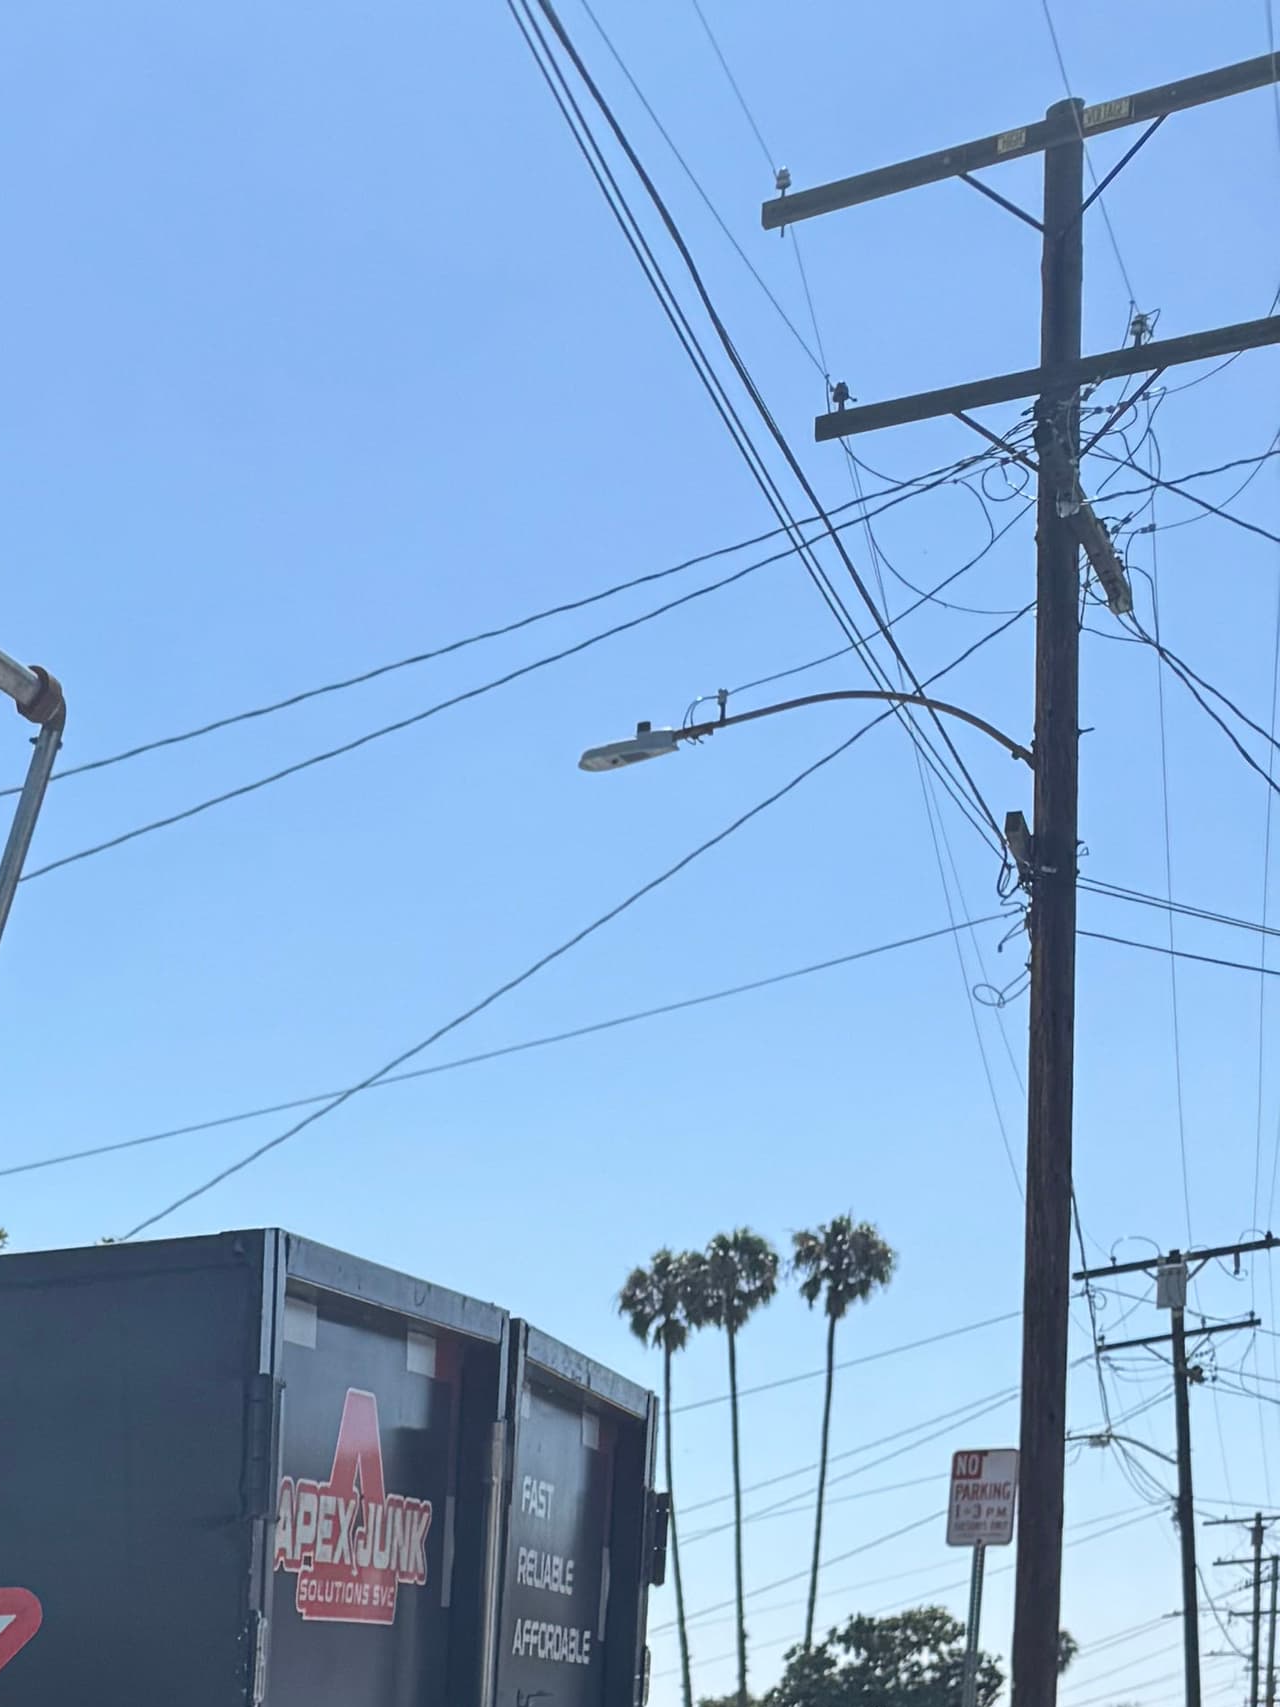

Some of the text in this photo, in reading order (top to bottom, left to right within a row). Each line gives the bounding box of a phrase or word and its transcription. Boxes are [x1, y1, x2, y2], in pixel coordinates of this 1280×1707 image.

[956, 1454, 980, 1476] NO
[521, 1475, 554, 1520] FAST
[954, 1482, 1011, 1502] PARKING
[274, 1490, 430, 1574] APEX JUNK
[299, 1579, 394, 1608] SOLUTIONS SVC
[517, 1547, 574, 1595] RELIABLE
[512, 1618, 591, 1665] AFFORDABLE
